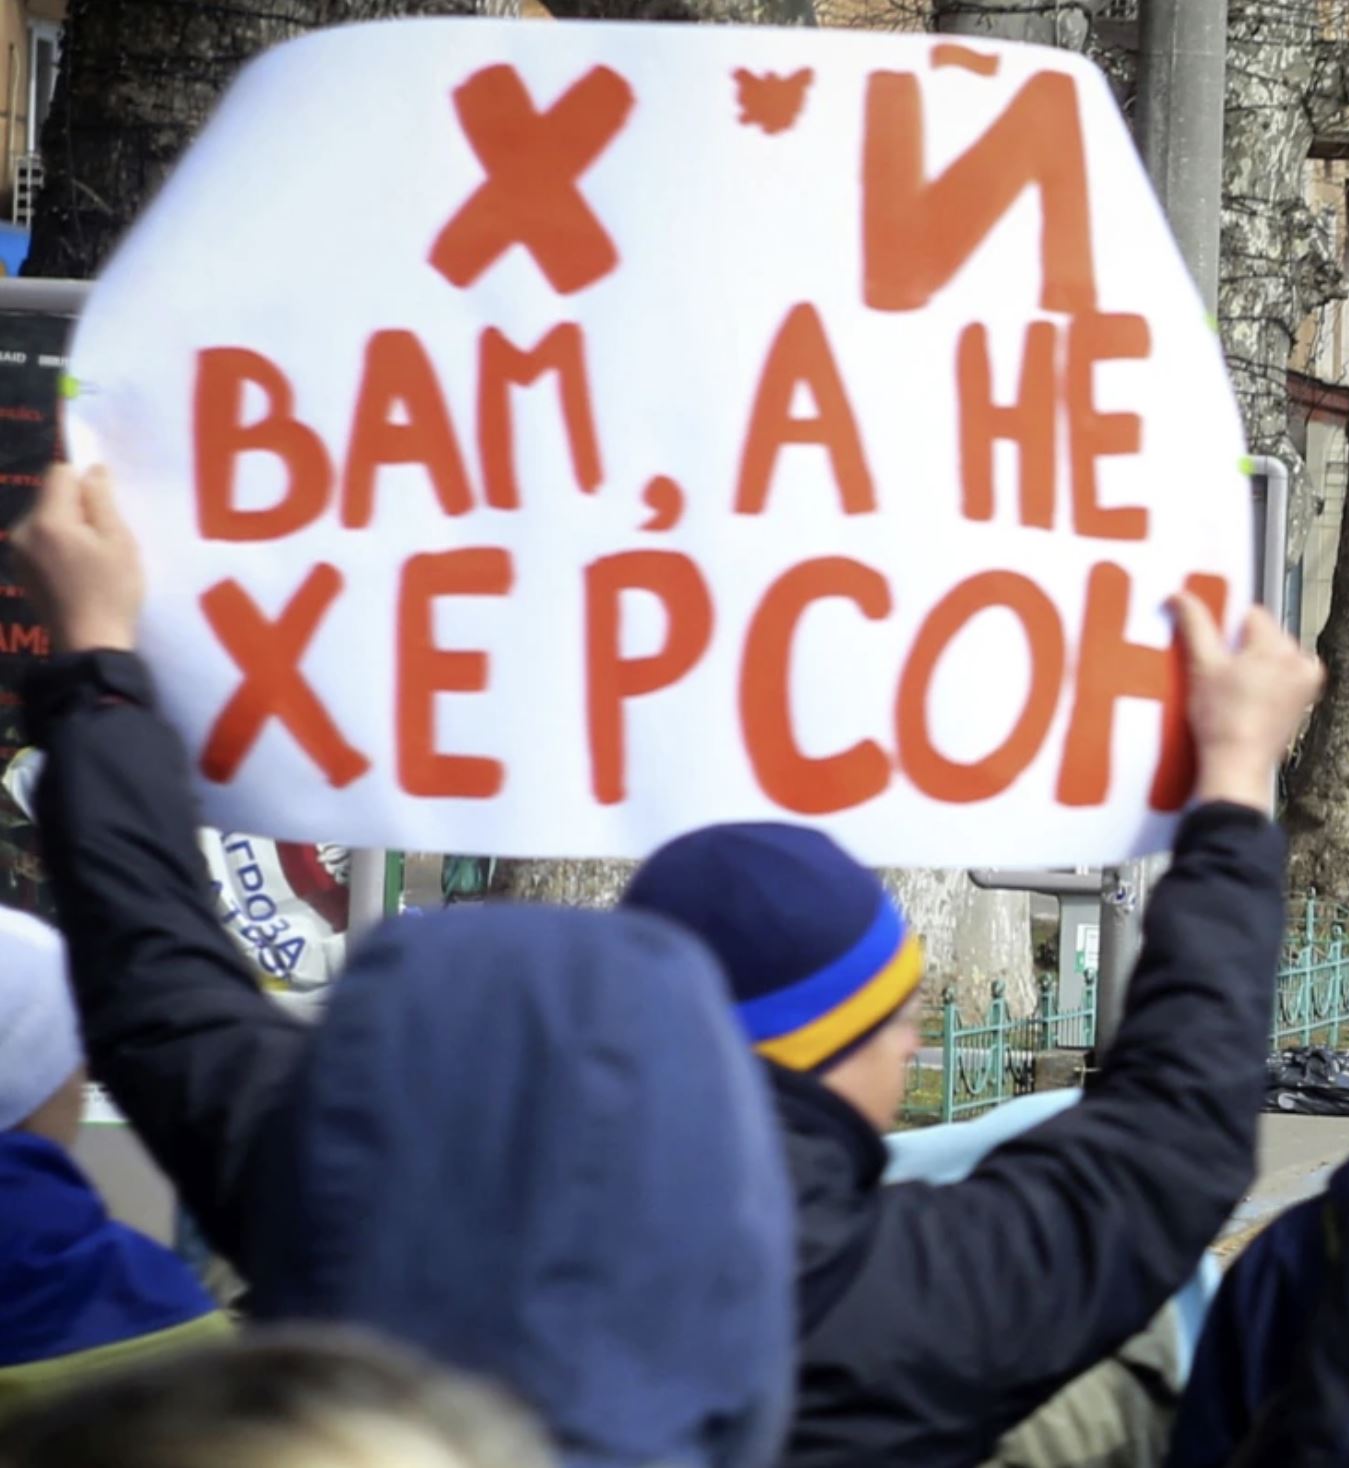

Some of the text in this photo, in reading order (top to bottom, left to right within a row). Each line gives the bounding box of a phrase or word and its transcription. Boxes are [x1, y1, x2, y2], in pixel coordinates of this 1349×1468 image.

[192, 301, 1152, 542] ВАМ, А НЕ
[198, 546, 1230, 816] ХЕРСОН
[222, 832, 306, 971] ГРОЗА
